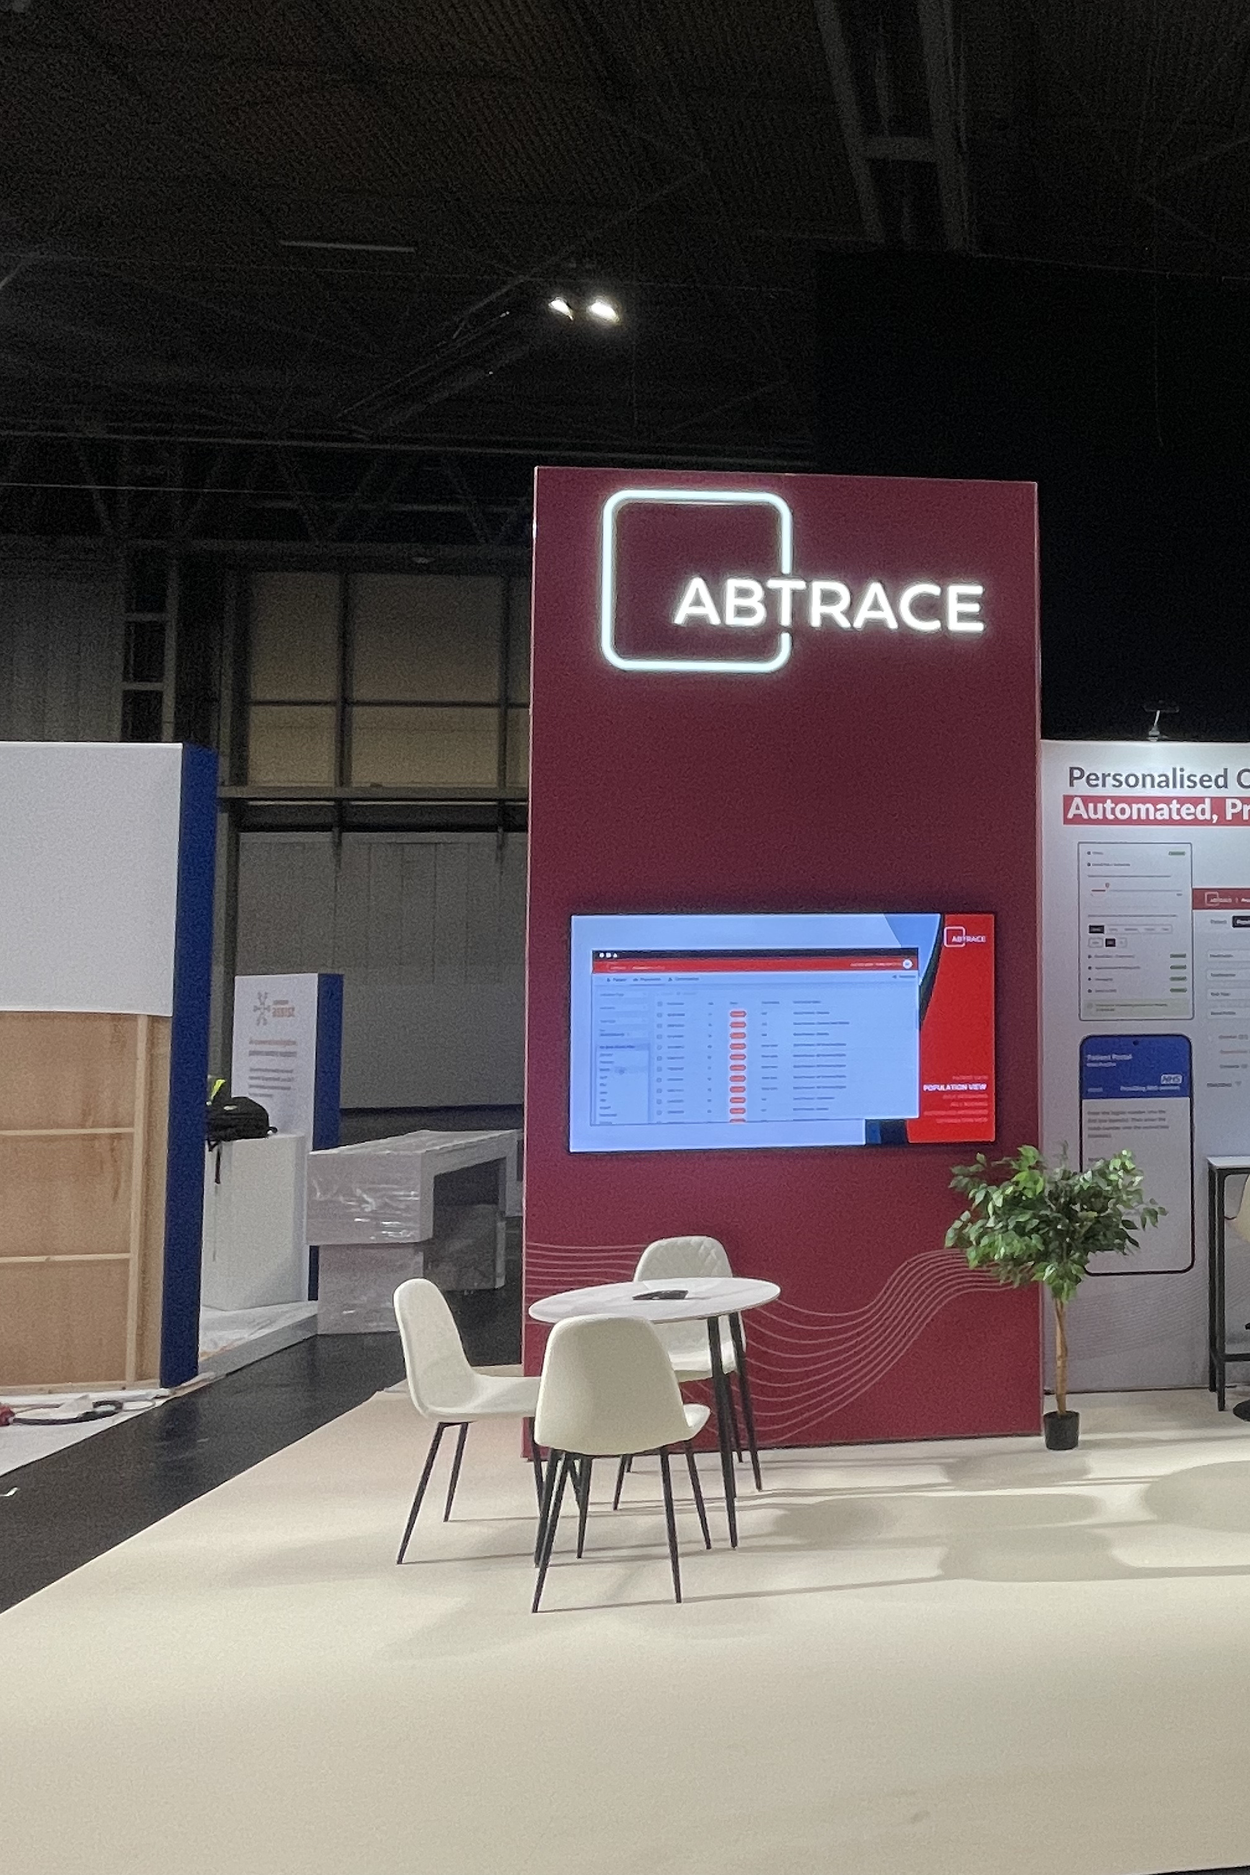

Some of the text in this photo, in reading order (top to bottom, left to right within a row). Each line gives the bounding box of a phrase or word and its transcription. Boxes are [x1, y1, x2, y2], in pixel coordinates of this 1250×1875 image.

[673, 576, 985, 633] ABTRACE
[1068, 766, 1229, 790] Personalised
[1067, 797, 1218, 823] Automated,
